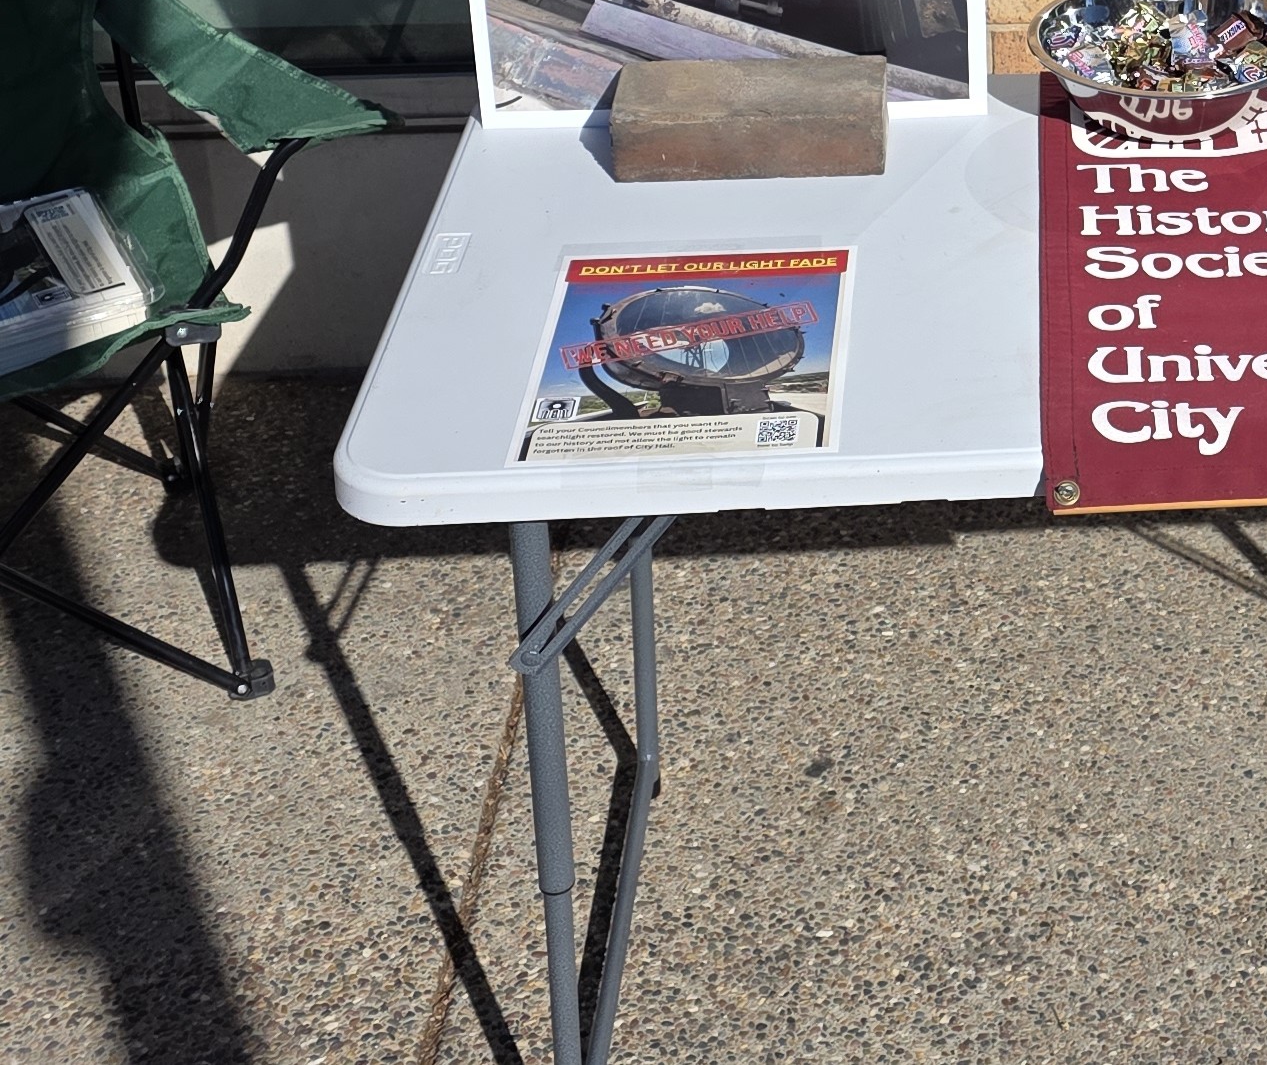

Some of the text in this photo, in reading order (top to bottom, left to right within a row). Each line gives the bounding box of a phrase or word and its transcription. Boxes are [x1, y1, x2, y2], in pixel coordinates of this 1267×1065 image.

[1076, 163, 1209, 194] The
[646, 262, 679, 273] LET
[684, 261, 726, 272] OUR
[729, 259, 785, 270] LIGHT
[789, 257, 837, 267] FADE
[1087, 294, 1162, 331] of
[613, 332, 678, 357] NEED
[683, 318, 745, 343] YOUR
[749, 306, 808, 332] HELP
[578, 425, 652, 433] Councilmembers
[1091, 400, 1245, 456] City
